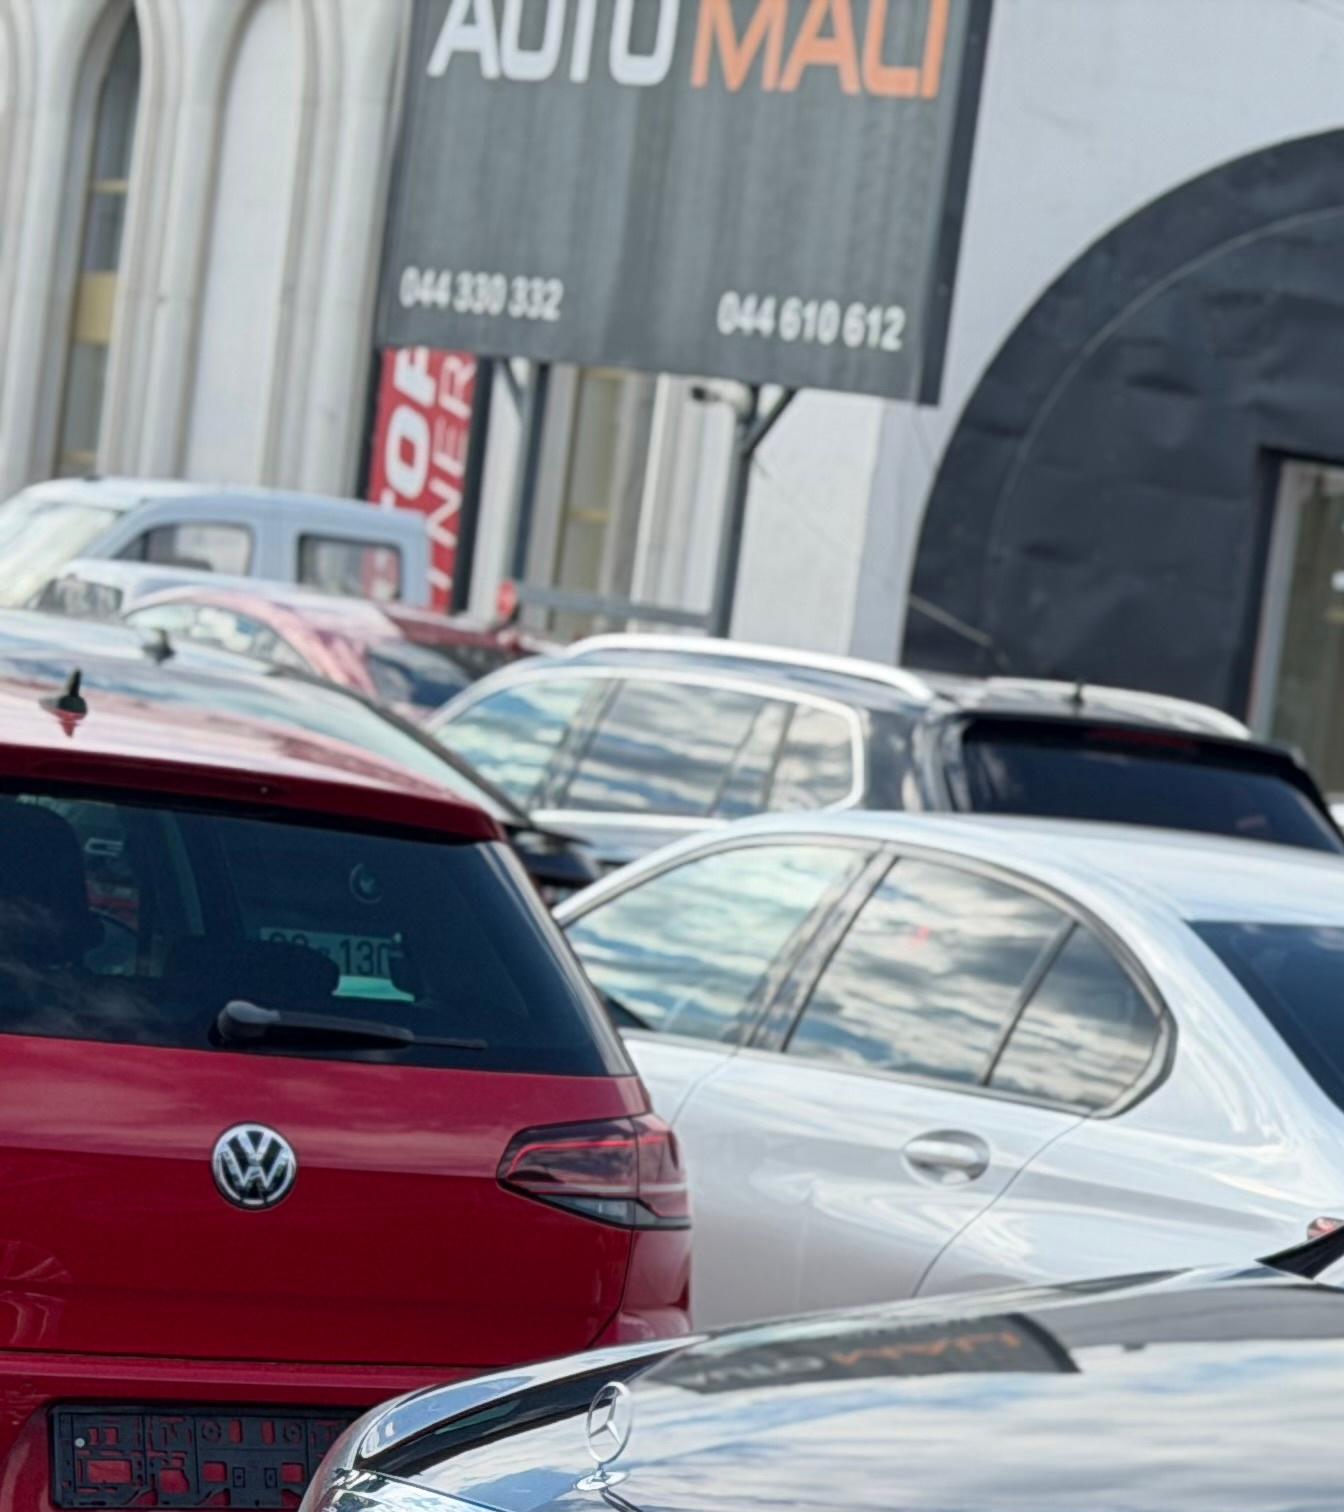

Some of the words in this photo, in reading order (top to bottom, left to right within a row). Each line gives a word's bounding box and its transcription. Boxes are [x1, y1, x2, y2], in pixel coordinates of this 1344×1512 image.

[691, 0, 950, 98] MALI
[400, 266, 450, 308] 044
[508, 276, 564, 321] 332
[717, 289, 775, 338] 044
[778, 296, 840, 344] 610
[842, 301, 906, 351] 612
